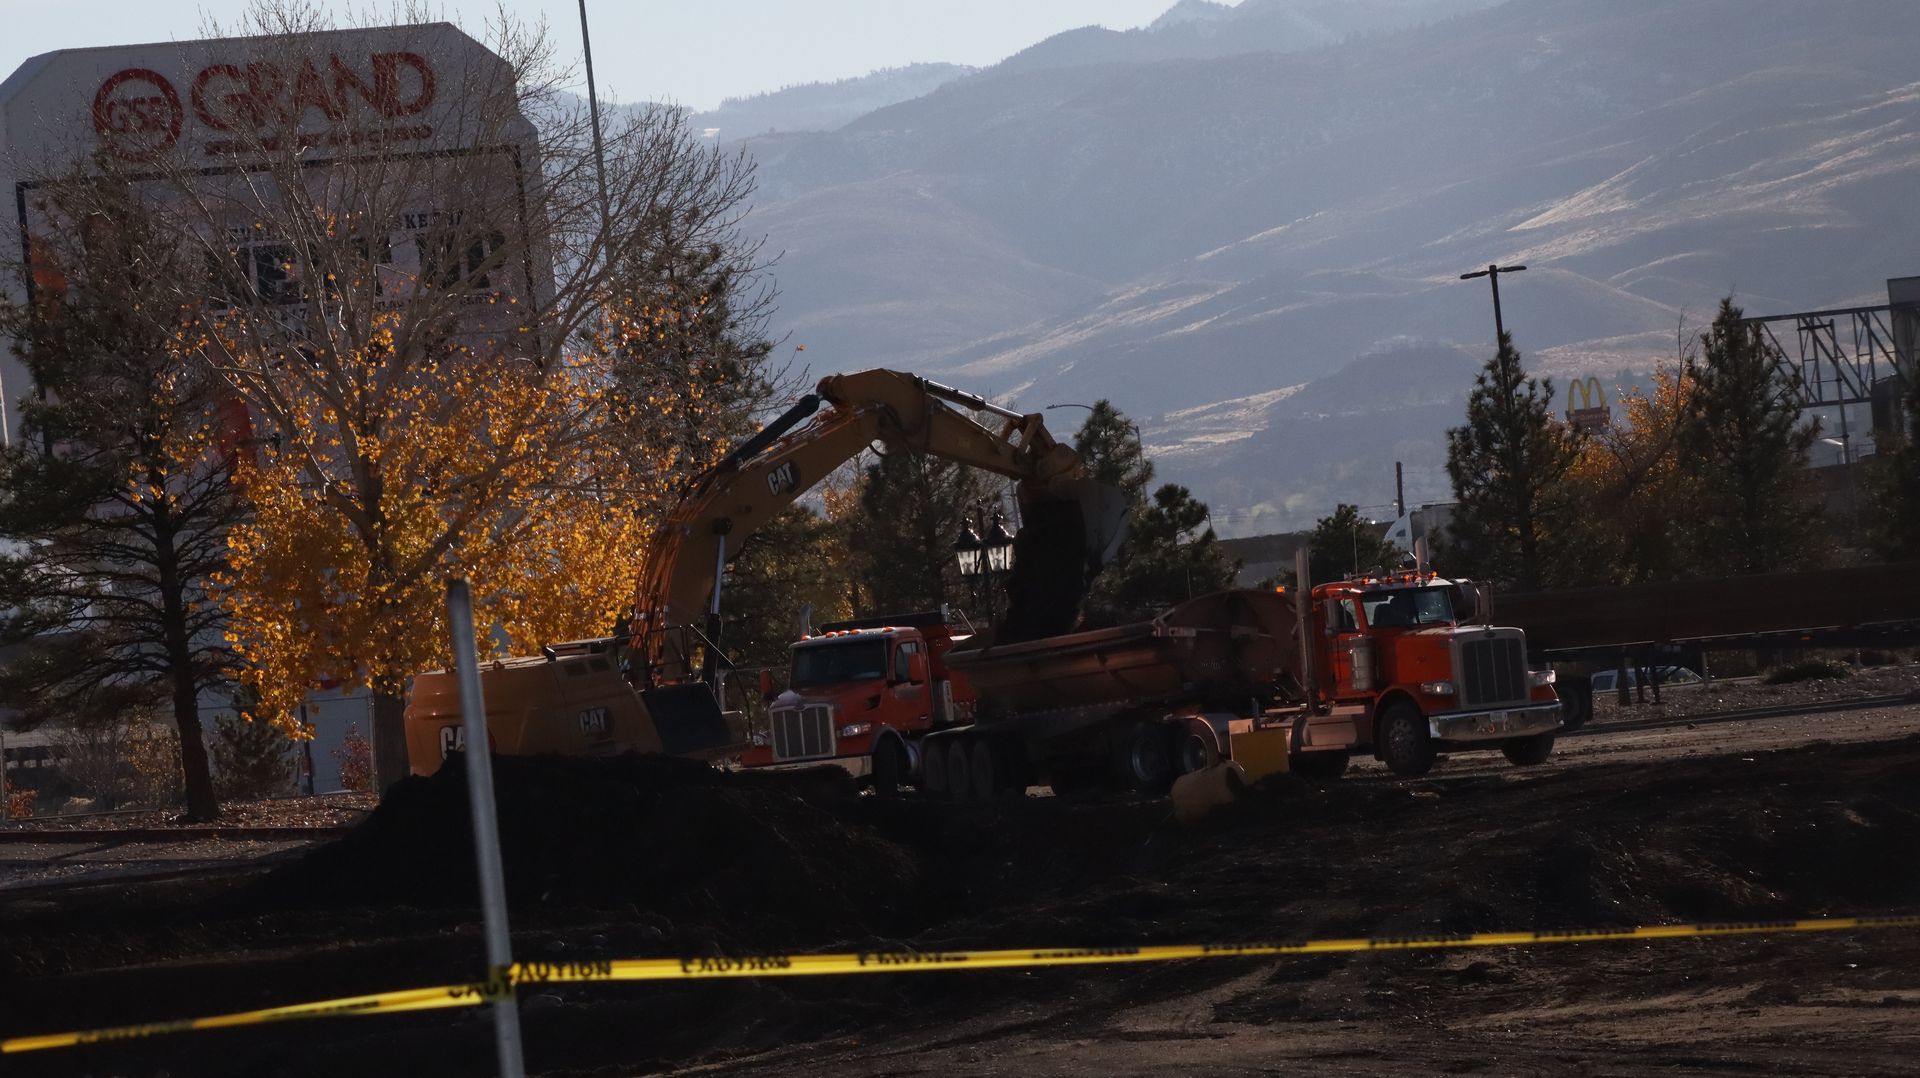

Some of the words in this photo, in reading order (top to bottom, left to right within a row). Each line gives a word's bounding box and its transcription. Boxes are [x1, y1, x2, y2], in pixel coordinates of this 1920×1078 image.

[192, 52, 436, 131] GRAND
[767, 461, 794, 496] CAT
[579, 708, 608, 735] CAT
